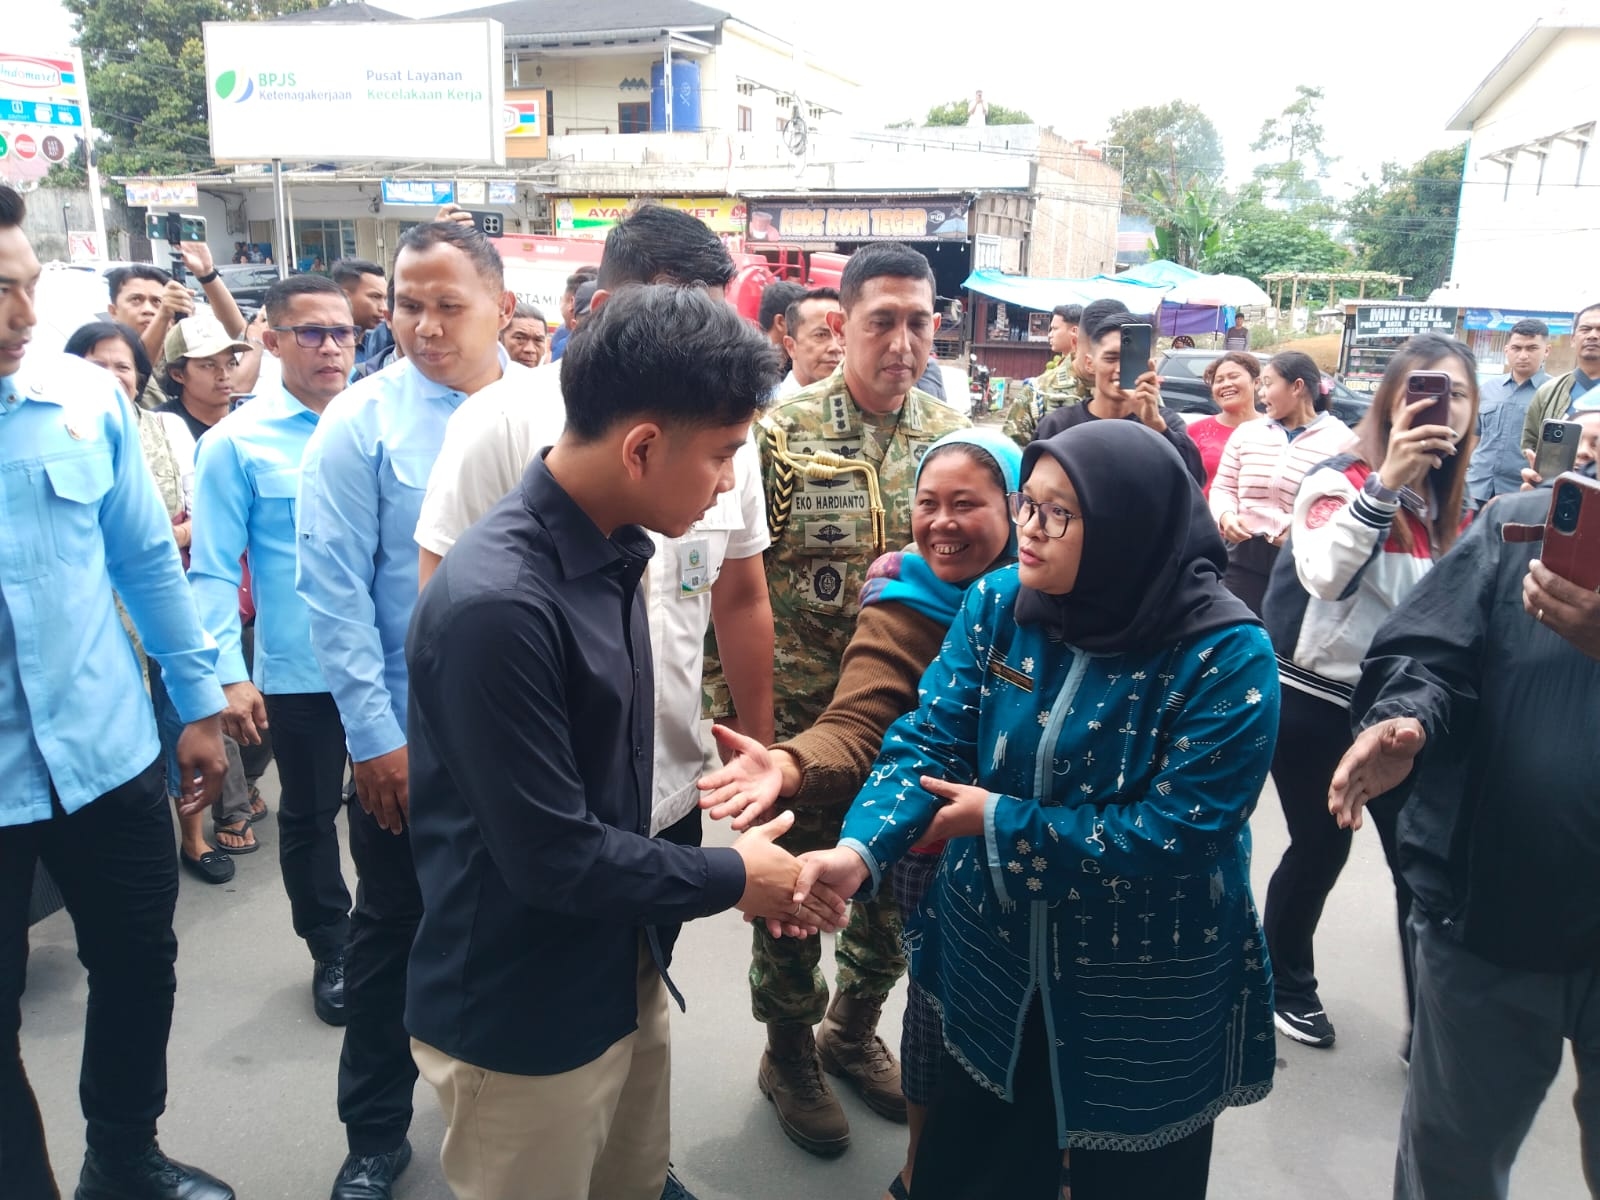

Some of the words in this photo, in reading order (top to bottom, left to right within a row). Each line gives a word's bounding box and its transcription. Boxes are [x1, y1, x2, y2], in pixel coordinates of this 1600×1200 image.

[0, 63, 56, 83] Indomaret
[258, 71, 297, 87] BPJS
[366, 69, 402, 81] Pusat
[407, 69, 463, 84] Layanan
[258, 88, 352, 102] Ketenagakerjaan
[367, 88, 443, 101] Kecelakaan
[447, 88, 483, 103] Kerja
[780, 208, 826, 236] KEDE
[870, 208, 928, 236] TEGER
[1369, 307, 1406, 321] MINI
[1409, 307, 1443, 321] CELL
[795, 495, 812, 510] EKO
[816, 494, 865, 510] HARDIANTO
